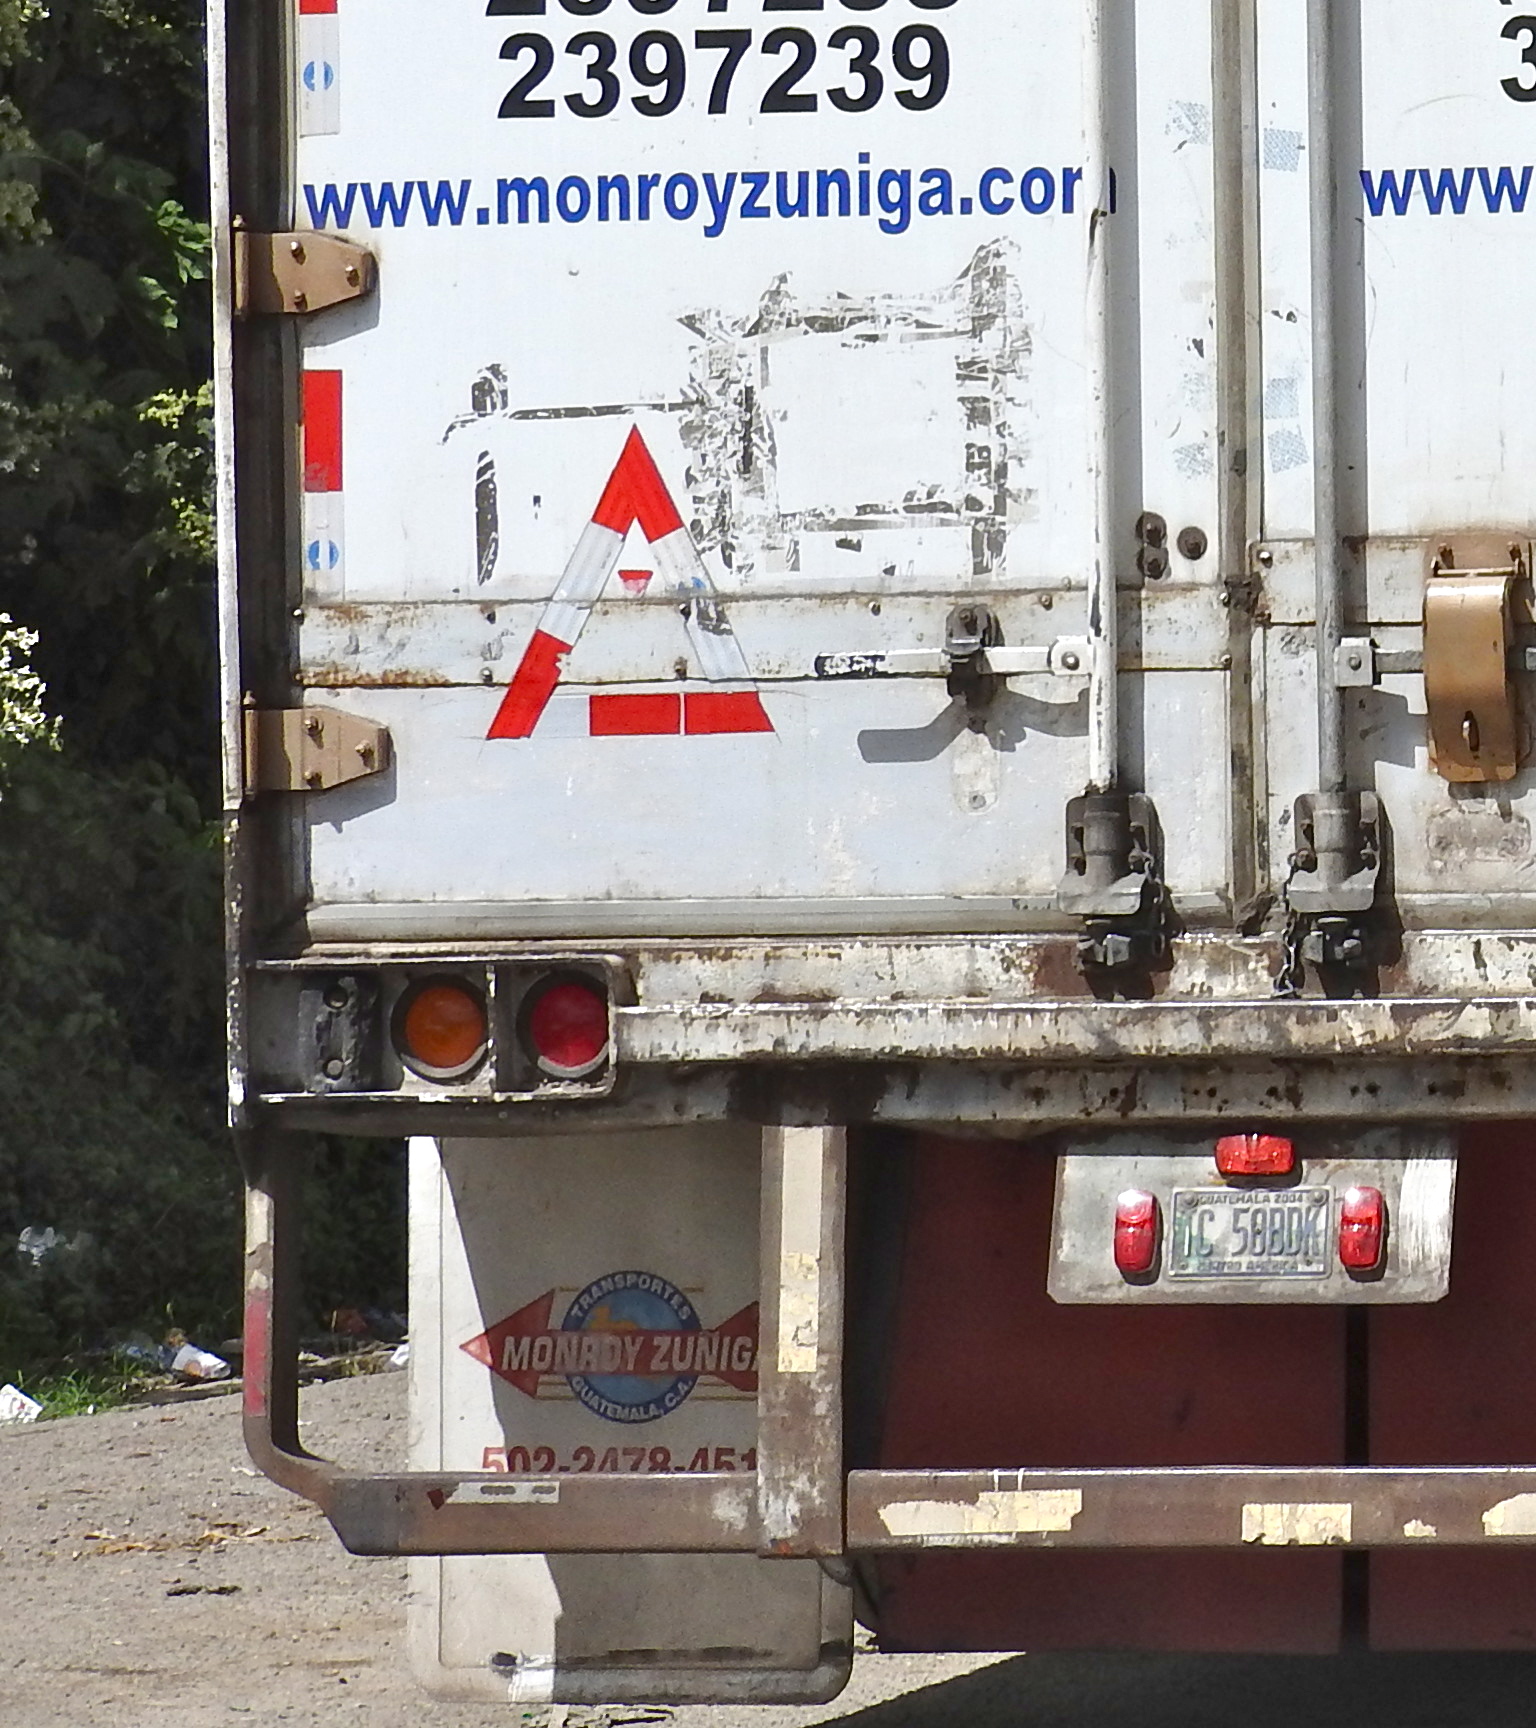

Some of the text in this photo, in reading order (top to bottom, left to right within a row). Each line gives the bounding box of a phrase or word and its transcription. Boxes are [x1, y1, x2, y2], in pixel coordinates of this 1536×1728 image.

[498, 24, 949, 118] 2397239
[1200, 1193, 1271, 1205] GUATEMALA
[571, 1274, 691, 1320] TRANSPORTES
[502, 1334, 645, 1372] MONROY
[572, 1376, 692, 1420] GUATEMALA, C.A.
